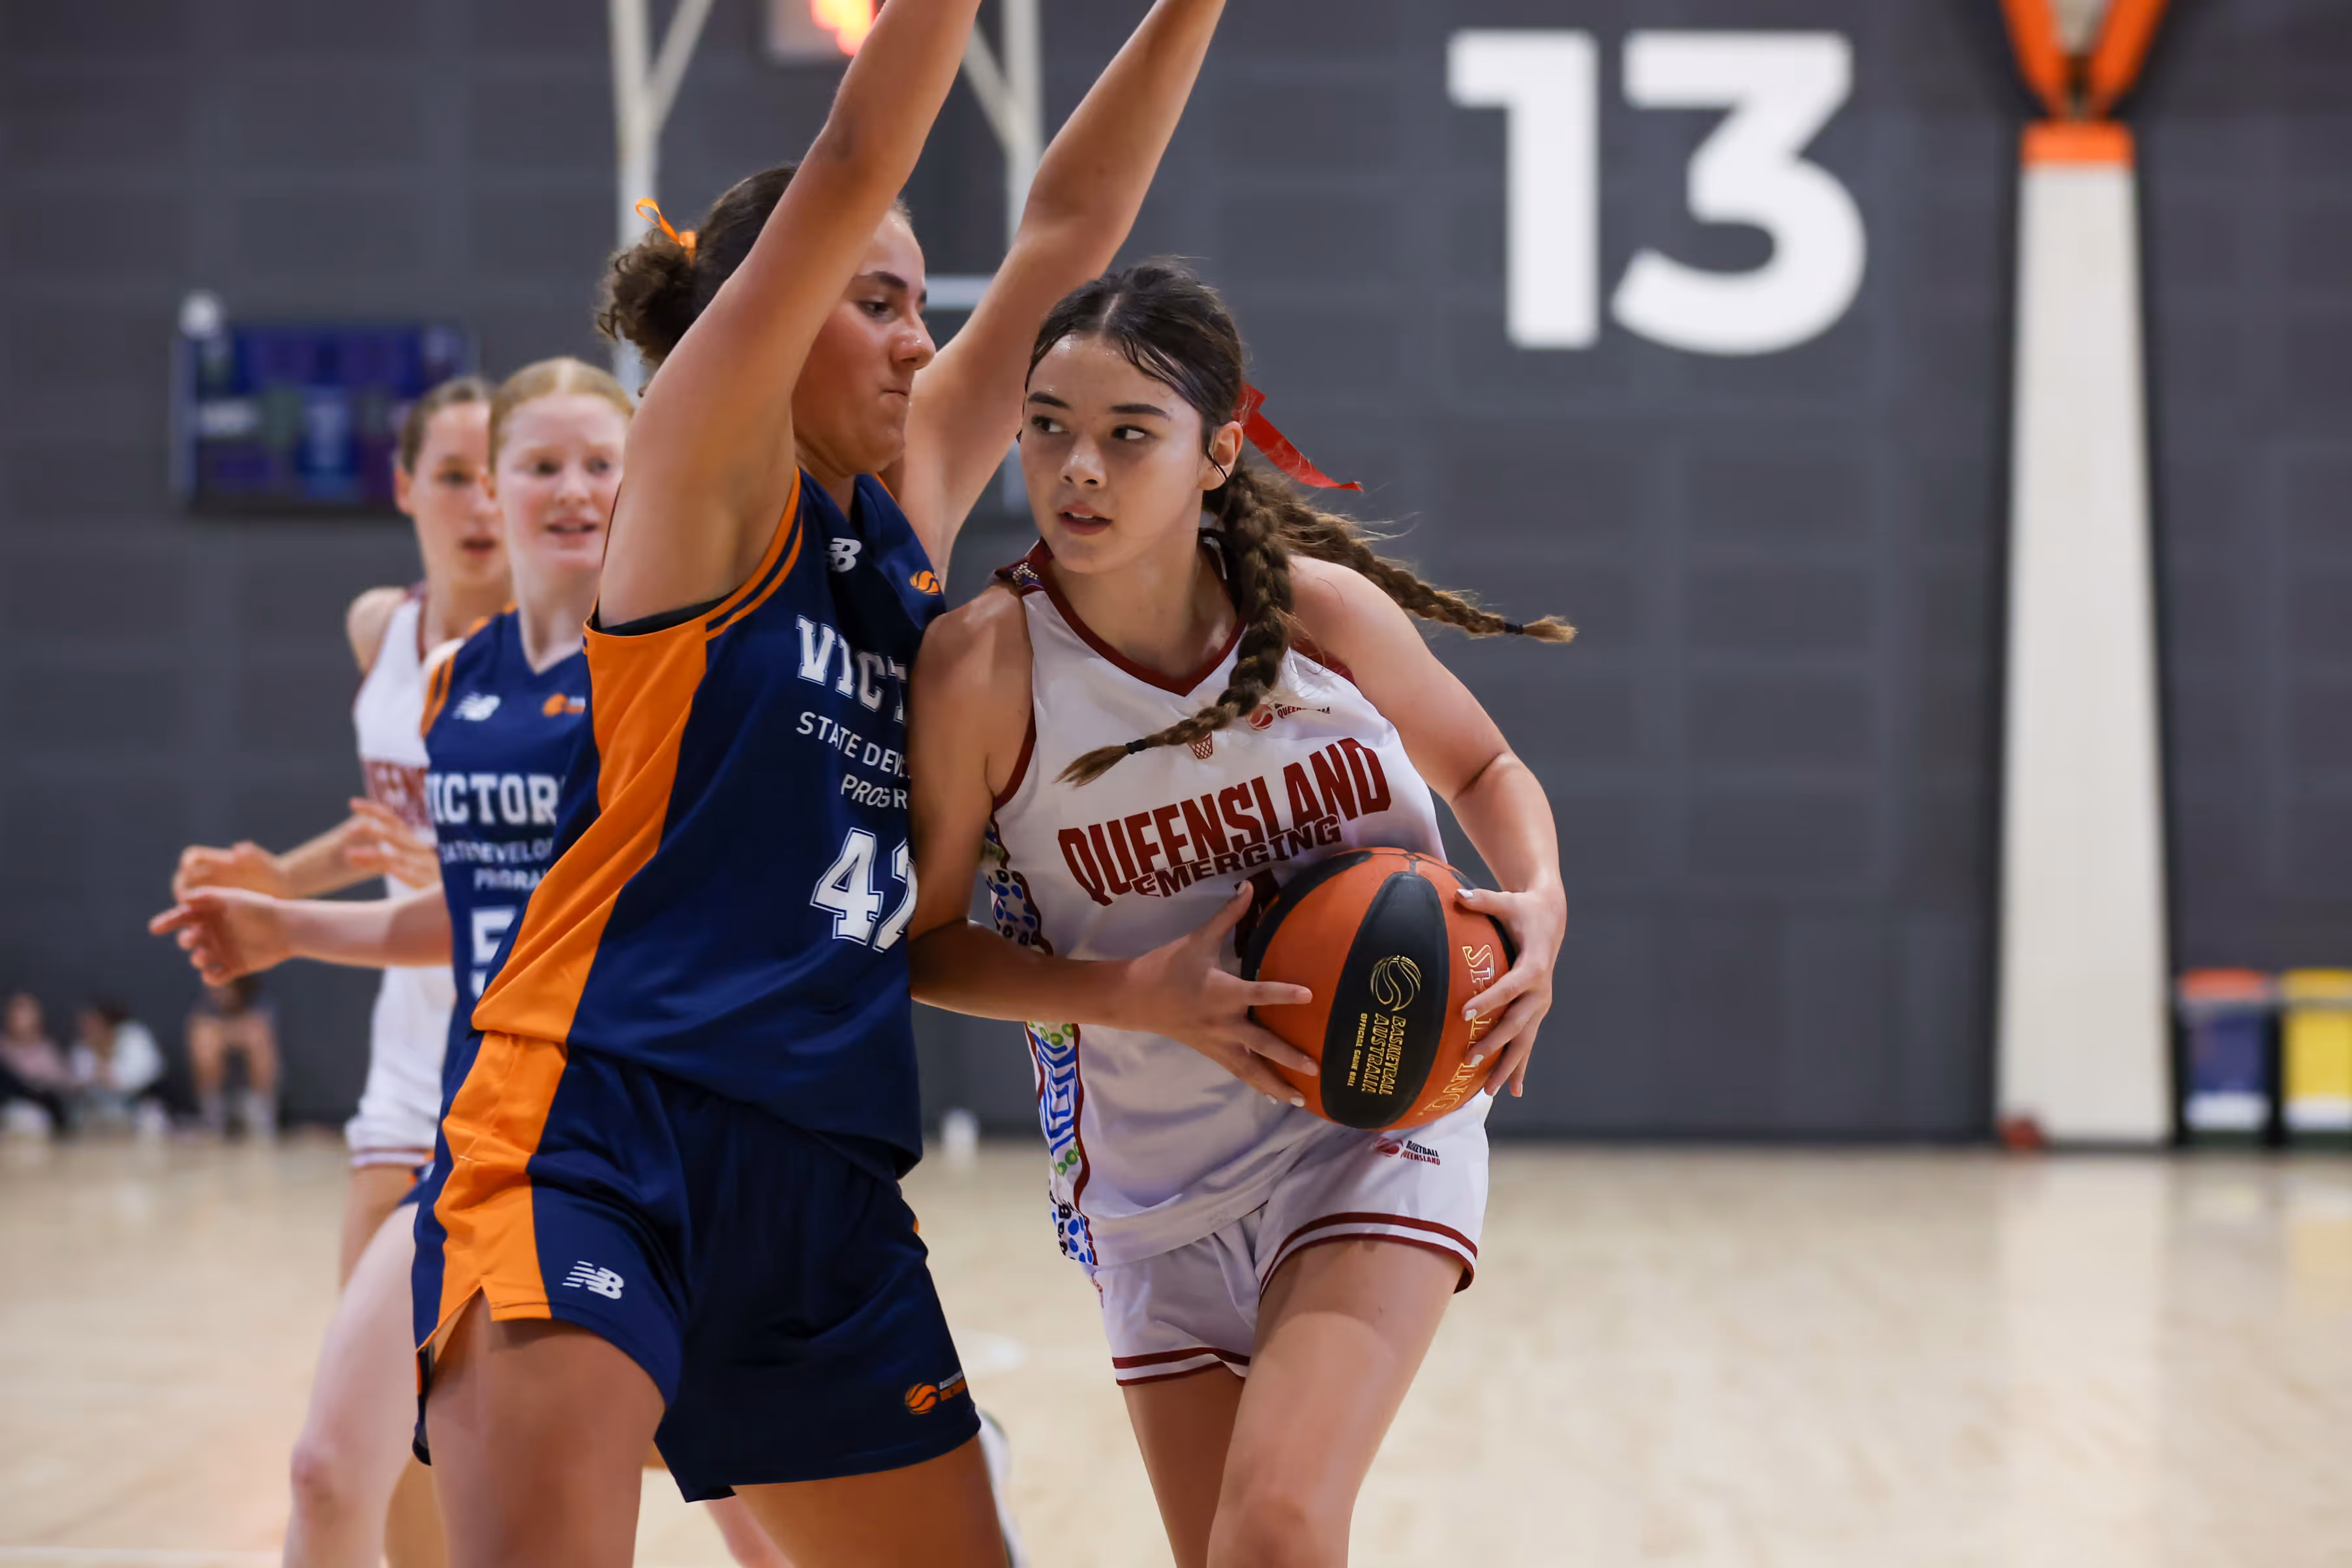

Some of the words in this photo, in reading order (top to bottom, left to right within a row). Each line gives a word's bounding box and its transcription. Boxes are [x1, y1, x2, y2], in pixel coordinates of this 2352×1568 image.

[1447, 29, 1867, 356] 13
[796, 711, 862, 758] STATE
[425, 772, 565, 826] ICTOR
[840, 774, 908, 809] PROGR
[1057, 737, 1392, 907] QUEENSLAND
[1128, 813, 1342, 899] EMERGING
[809, 826, 918, 954] 42
[1351, 1049, 1361, 1070] GAME
[1355, 1012, 1368, 1048] OFFICIAL
[1361, 1012, 1390, 1093] AUSTRALIA
[1379, 1015, 1406, 1095] BASKETBALL
[1347, 1071, 1357, 1087] BALL
